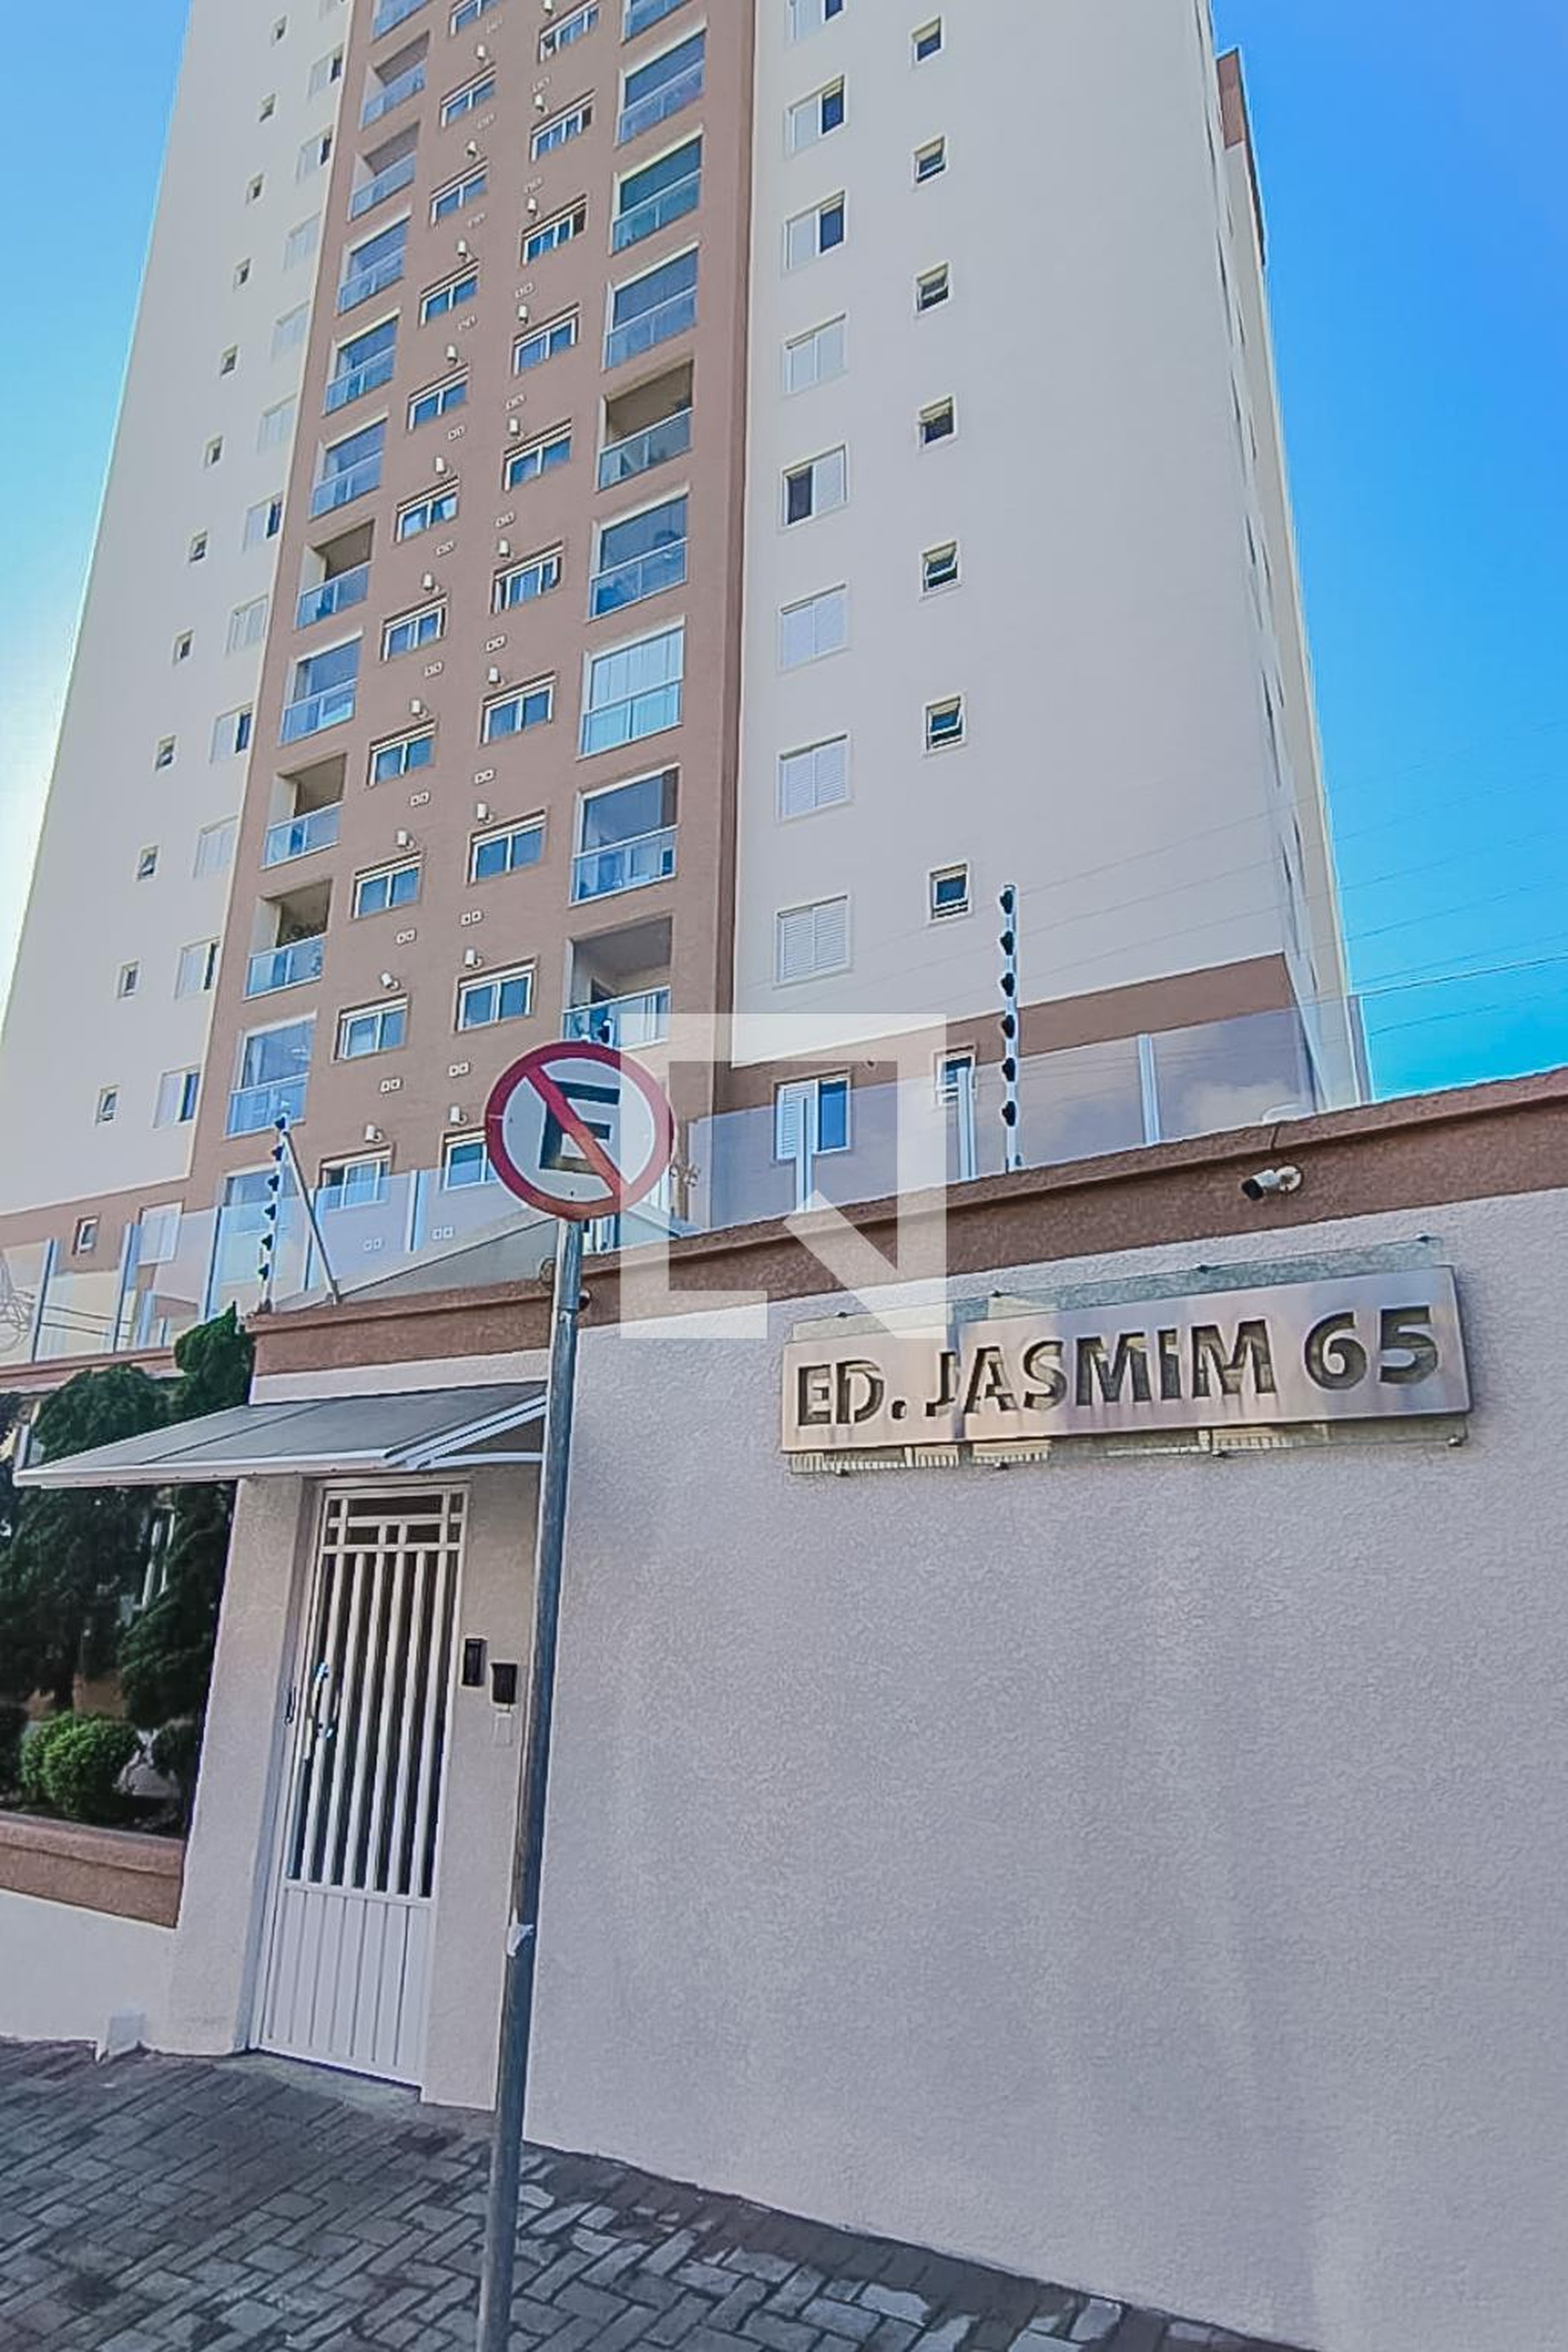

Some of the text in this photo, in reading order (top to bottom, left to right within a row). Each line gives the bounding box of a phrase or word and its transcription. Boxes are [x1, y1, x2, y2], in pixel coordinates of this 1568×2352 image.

[539, 1080, 620, 1176] E
[798, 1305, 1438, 1426] ED. JASMIM 65
